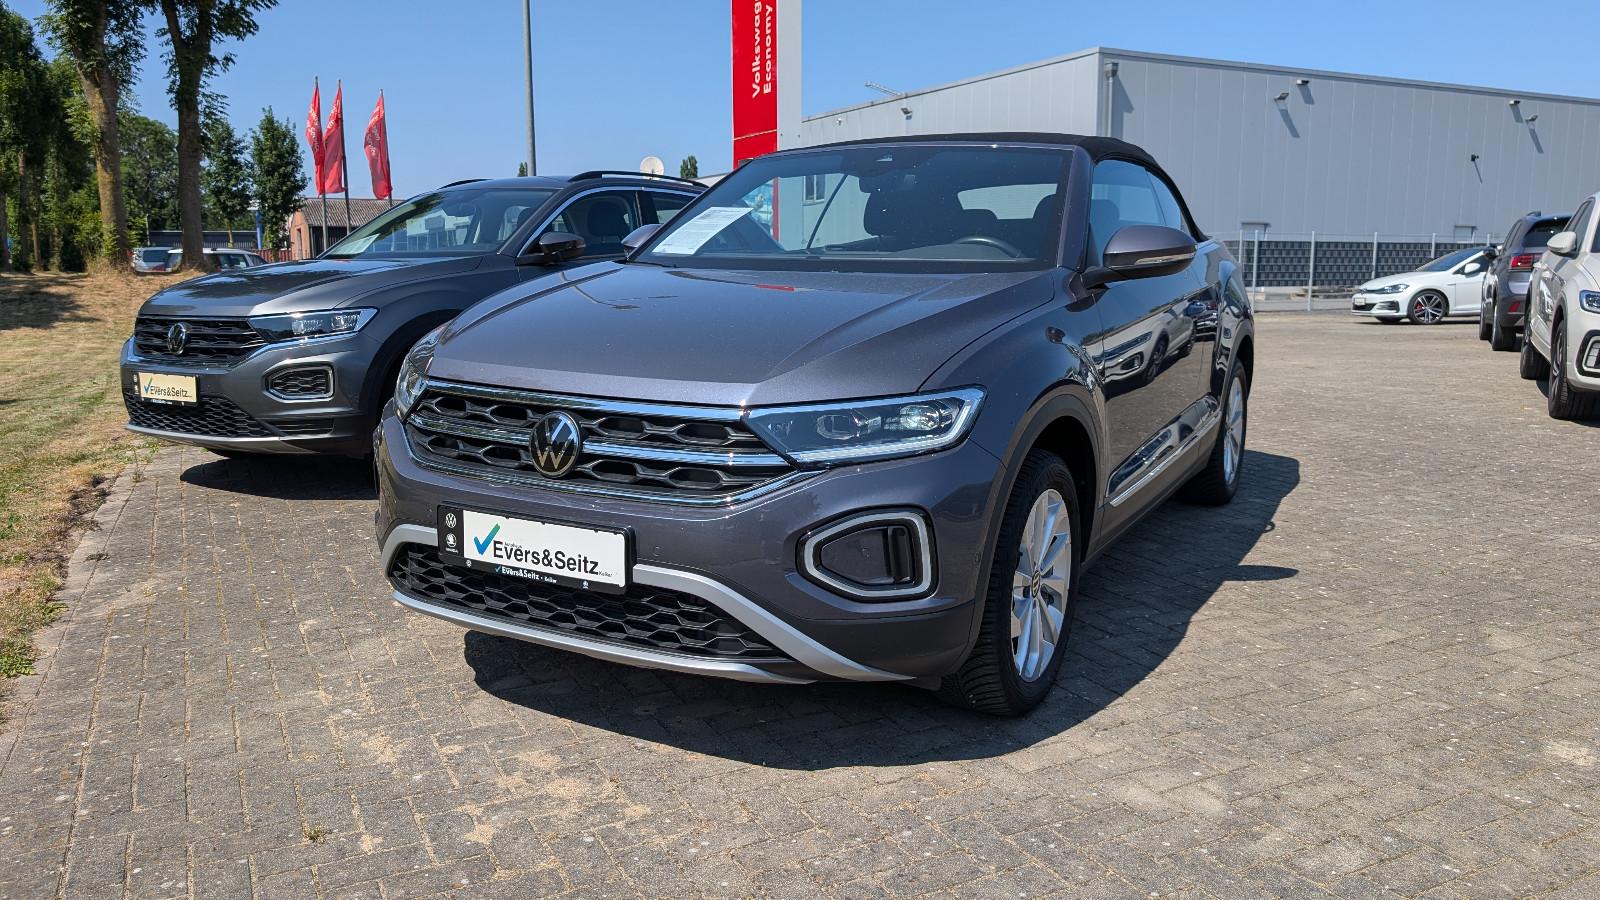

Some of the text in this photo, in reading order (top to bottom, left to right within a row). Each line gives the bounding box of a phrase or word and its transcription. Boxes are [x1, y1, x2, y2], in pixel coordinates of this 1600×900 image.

[752, 0, 763, 99] Volkswag
[763, 5, 773, 94] Economy
[150, 385, 188, 398] Evers&Seitz
[532, 413, 578, 474] VW
[493, 540, 599, 576] Evers&Seitz
[501, 565, 540, 580] Evers&Seitz
